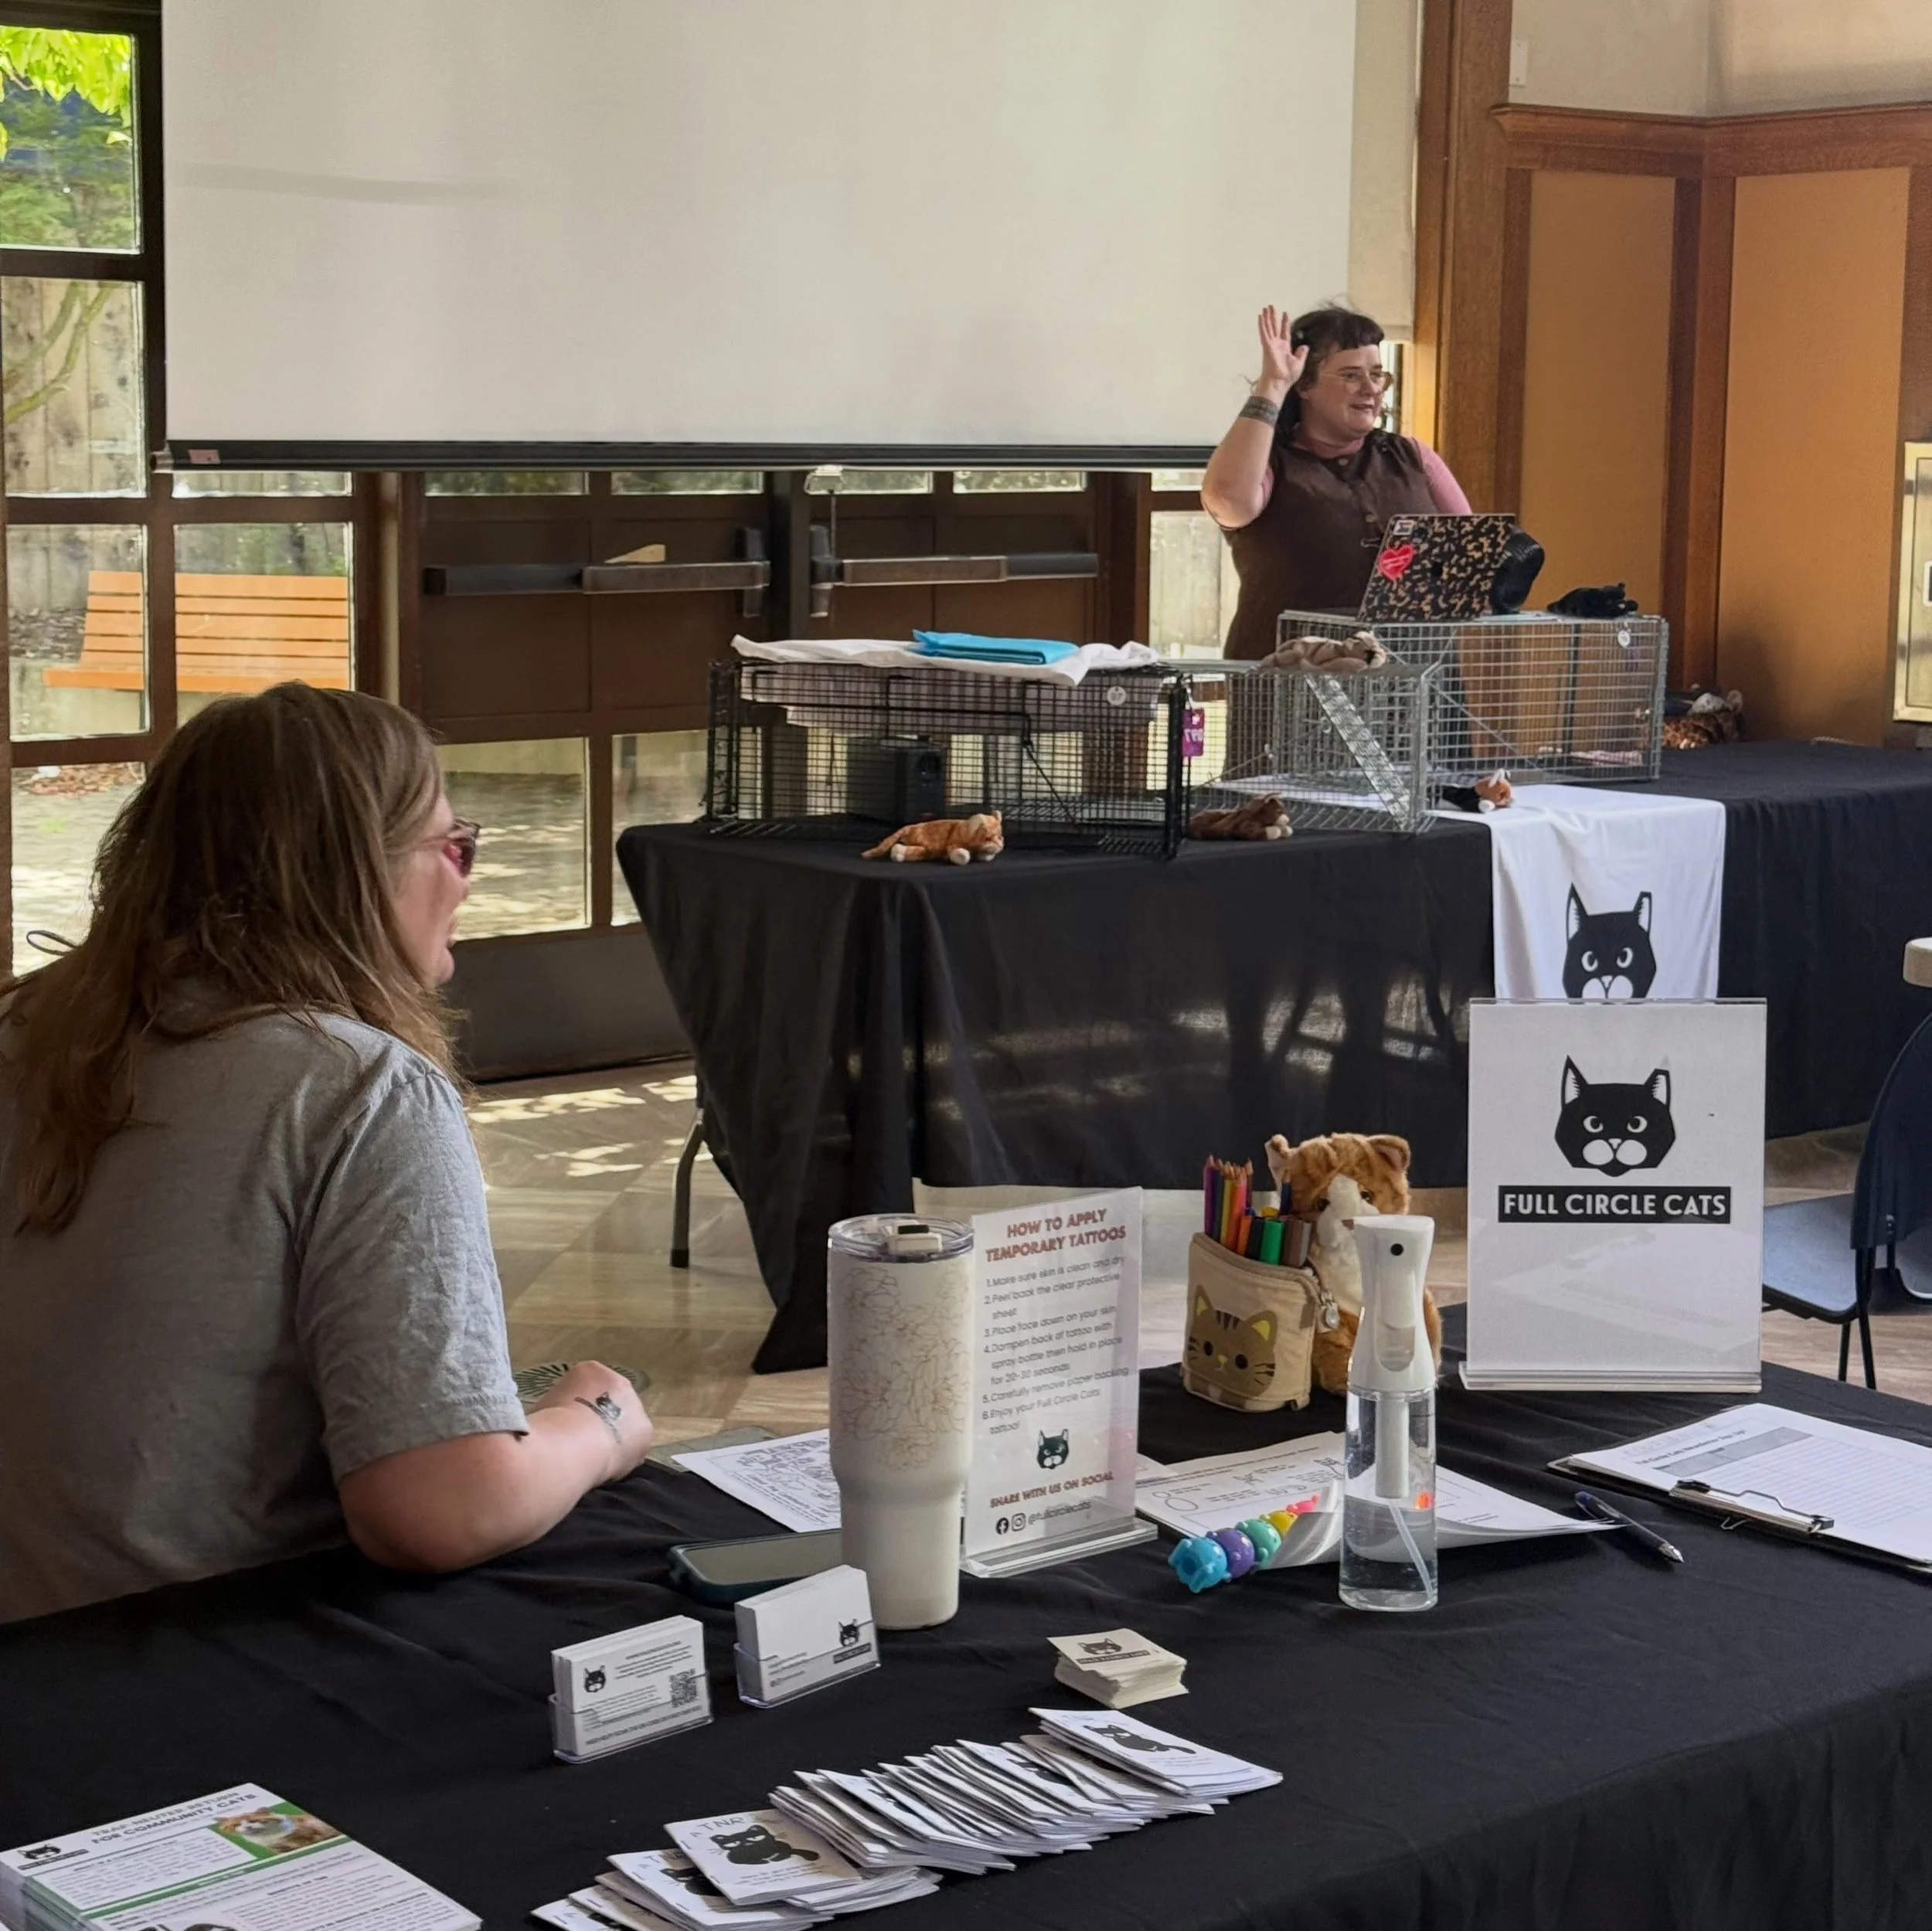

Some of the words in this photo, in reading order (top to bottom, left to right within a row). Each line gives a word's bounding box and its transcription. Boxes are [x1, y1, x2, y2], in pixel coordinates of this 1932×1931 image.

[1504, 1193, 1559, 1215] FULL
[1564, 1193, 1656, 1215] CIRCLE
[1663, 1194, 1726, 1215] CATS
[1007, 1220, 1042, 1238] HOW
[1045, 1216, 1063, 1231] TO
[1066, 1209, 1107, 1228] APPLY
[985, 1236, 1066, 1262] TEMPORARY
[1070, 1225, 1126, 1247] TATTOOS
[1017, 1272, 1036, 1282] sure
[1039, 1269, 1056, 1279] skin
[1066, 1262, 1090, 1273] clean
[1092, 1258, 1110, 1268] and
[1111, 1256, 1124, 1266] dry
[1012, 1288, 1034, 1300] back
[1036, 1286, 1050, 1295] the
[1052, 1281, 1075, 1293] clear
[1077, 1273, 1120, 1290] protective
[1018, 1321, 1039, 1331] face
[1040, 1316, 1064, 1327] down
[1066, 1313, 1077, 1321] on
[1079, 1309, 1098, 1322] your
[1100, 1305, 1117, 1315] skin
[1031, 1333, 1053, 1345] back
[1055, 1330, 1064, 1341] of
[1066, 1326, 1092, 1338] tattoo
[1094, 1322, 1113, 1332] with
[991, 1358, 1015, 1370] spray
[1017, 1352, 1044, 1363] bottle
[1067, 1341, 1087, 1353] hold
[1088, 1340, 1097, 1349] in
[1098, 1336, 1123, 1350] place
[991, 1375, 1003, 1385] for
[1033, 1363, 1070, 1376] seconds
[1066, 1374, 1093, 1389] paper
[1094, 1366, 1129, 1381] backing
[1015, 1402, 1036, 1415] your
[1036, 1397, 1052, 1408] Full
[1053, 1393, 1080, 1405] Circle
[1080, 1389, 1100, 1399] Cats
[990, 1492, 1020, 1508] SHARE
[1022, 1486, 1047, 1500] WITH
[1049, 1483, 1062, 1494] US
[1063, 1479, 1080, 1490] ON
[1081, 1471, 1114, 1486] SOCIAL
[91, 1834, 122, 1844] FOR
[124, 1807, 213, 1834] COMMUNITY
[216, 1793, 257, 1808] CATS
[698, 1816, 746, 1831] TNR
